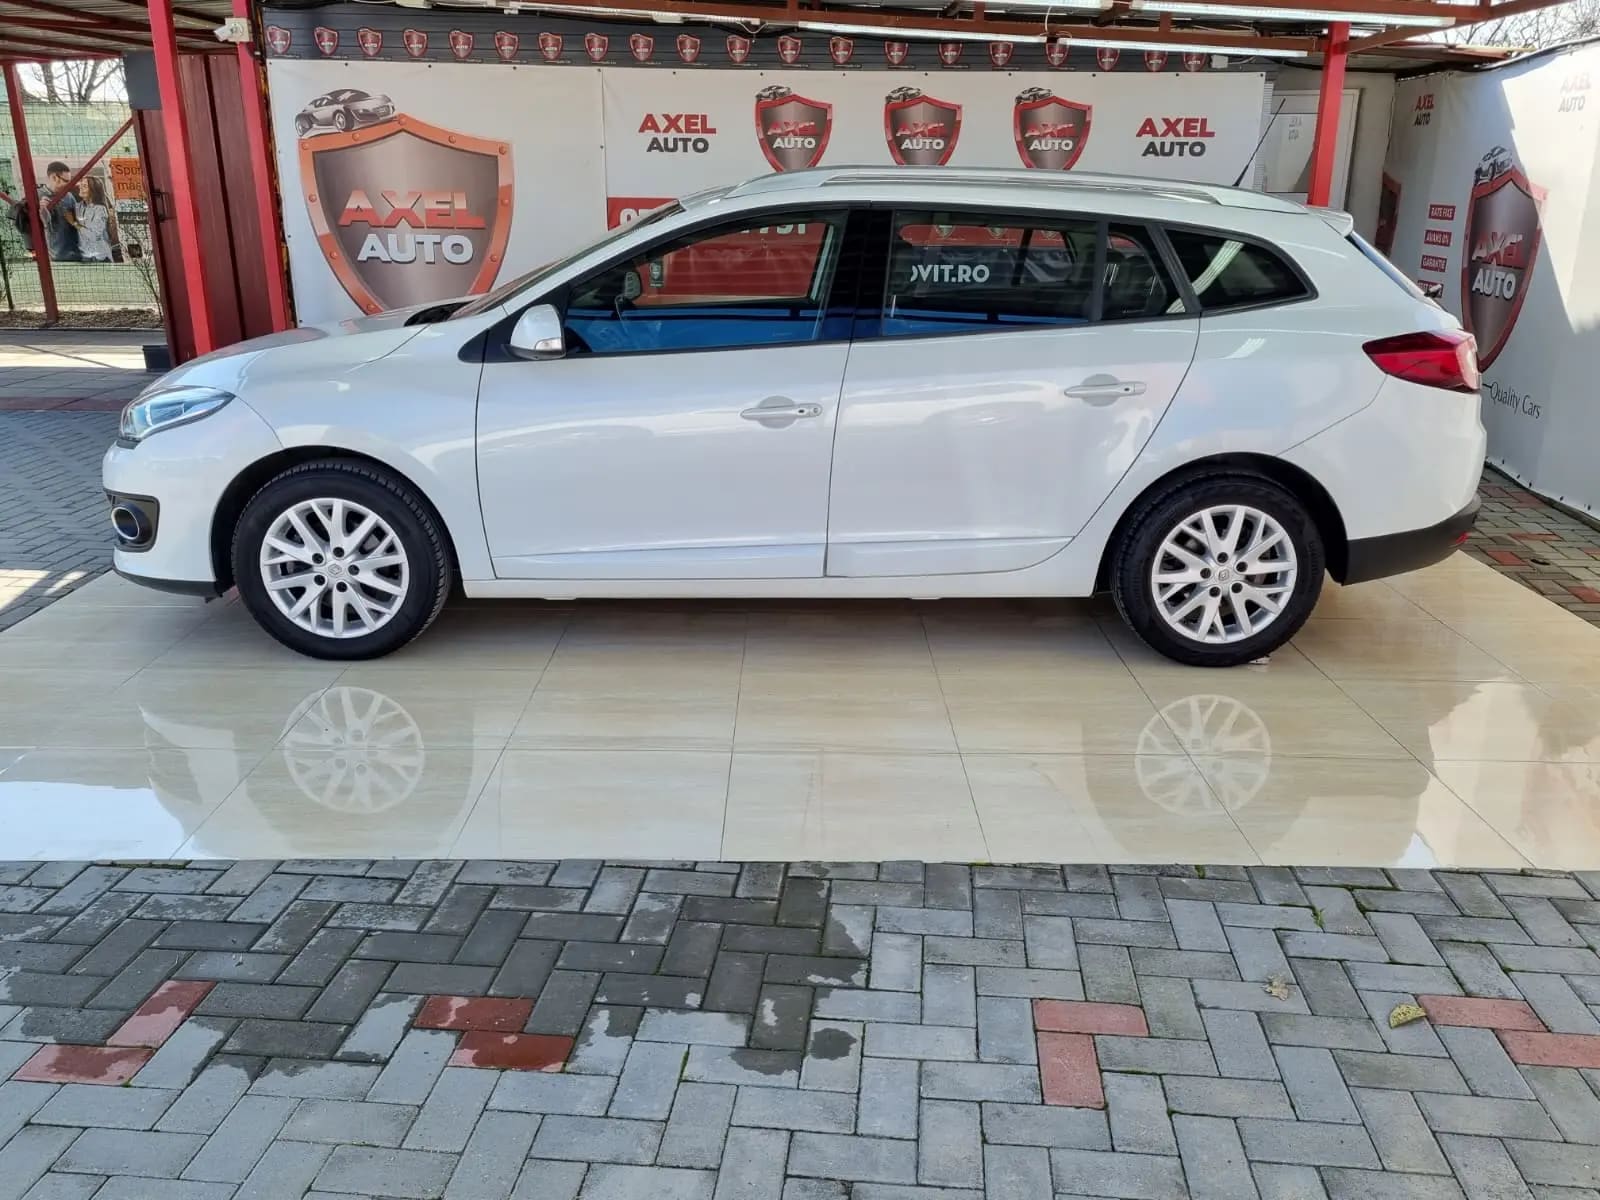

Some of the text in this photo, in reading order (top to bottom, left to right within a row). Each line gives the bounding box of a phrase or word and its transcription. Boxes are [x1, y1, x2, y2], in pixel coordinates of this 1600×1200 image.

[1415, 94, 1434, 112] AXEL
[1558, 95, 1586, 113] AUTO
[638, 113, 717, 134] AXEL
[1135, 117, 1216, 138] AXEL
[1414, 113, 1431, 126] AUTO
[767, 121, 818, 137] AXEL
[896, 122, 948, 138] AXEL
[1025, 122, 1078, 138] AXEL
[646, 137, 710, 154] AUTO
[772, 137, 817, 150] AUTO
[901, 138, 945, 150] AUTO
[1029, 139, 1074, 151] AUTO
[1141, 141, 1206, 157] AUTO
[338, 189, 486, 229] AXEL
[357, 233, 474, 265] AUTO
[1472, 232, 1525, 269] AXEL
[1472, 268, 1517, 301] AUTO
[1490, 381, 1542, 419] Quality Cars
